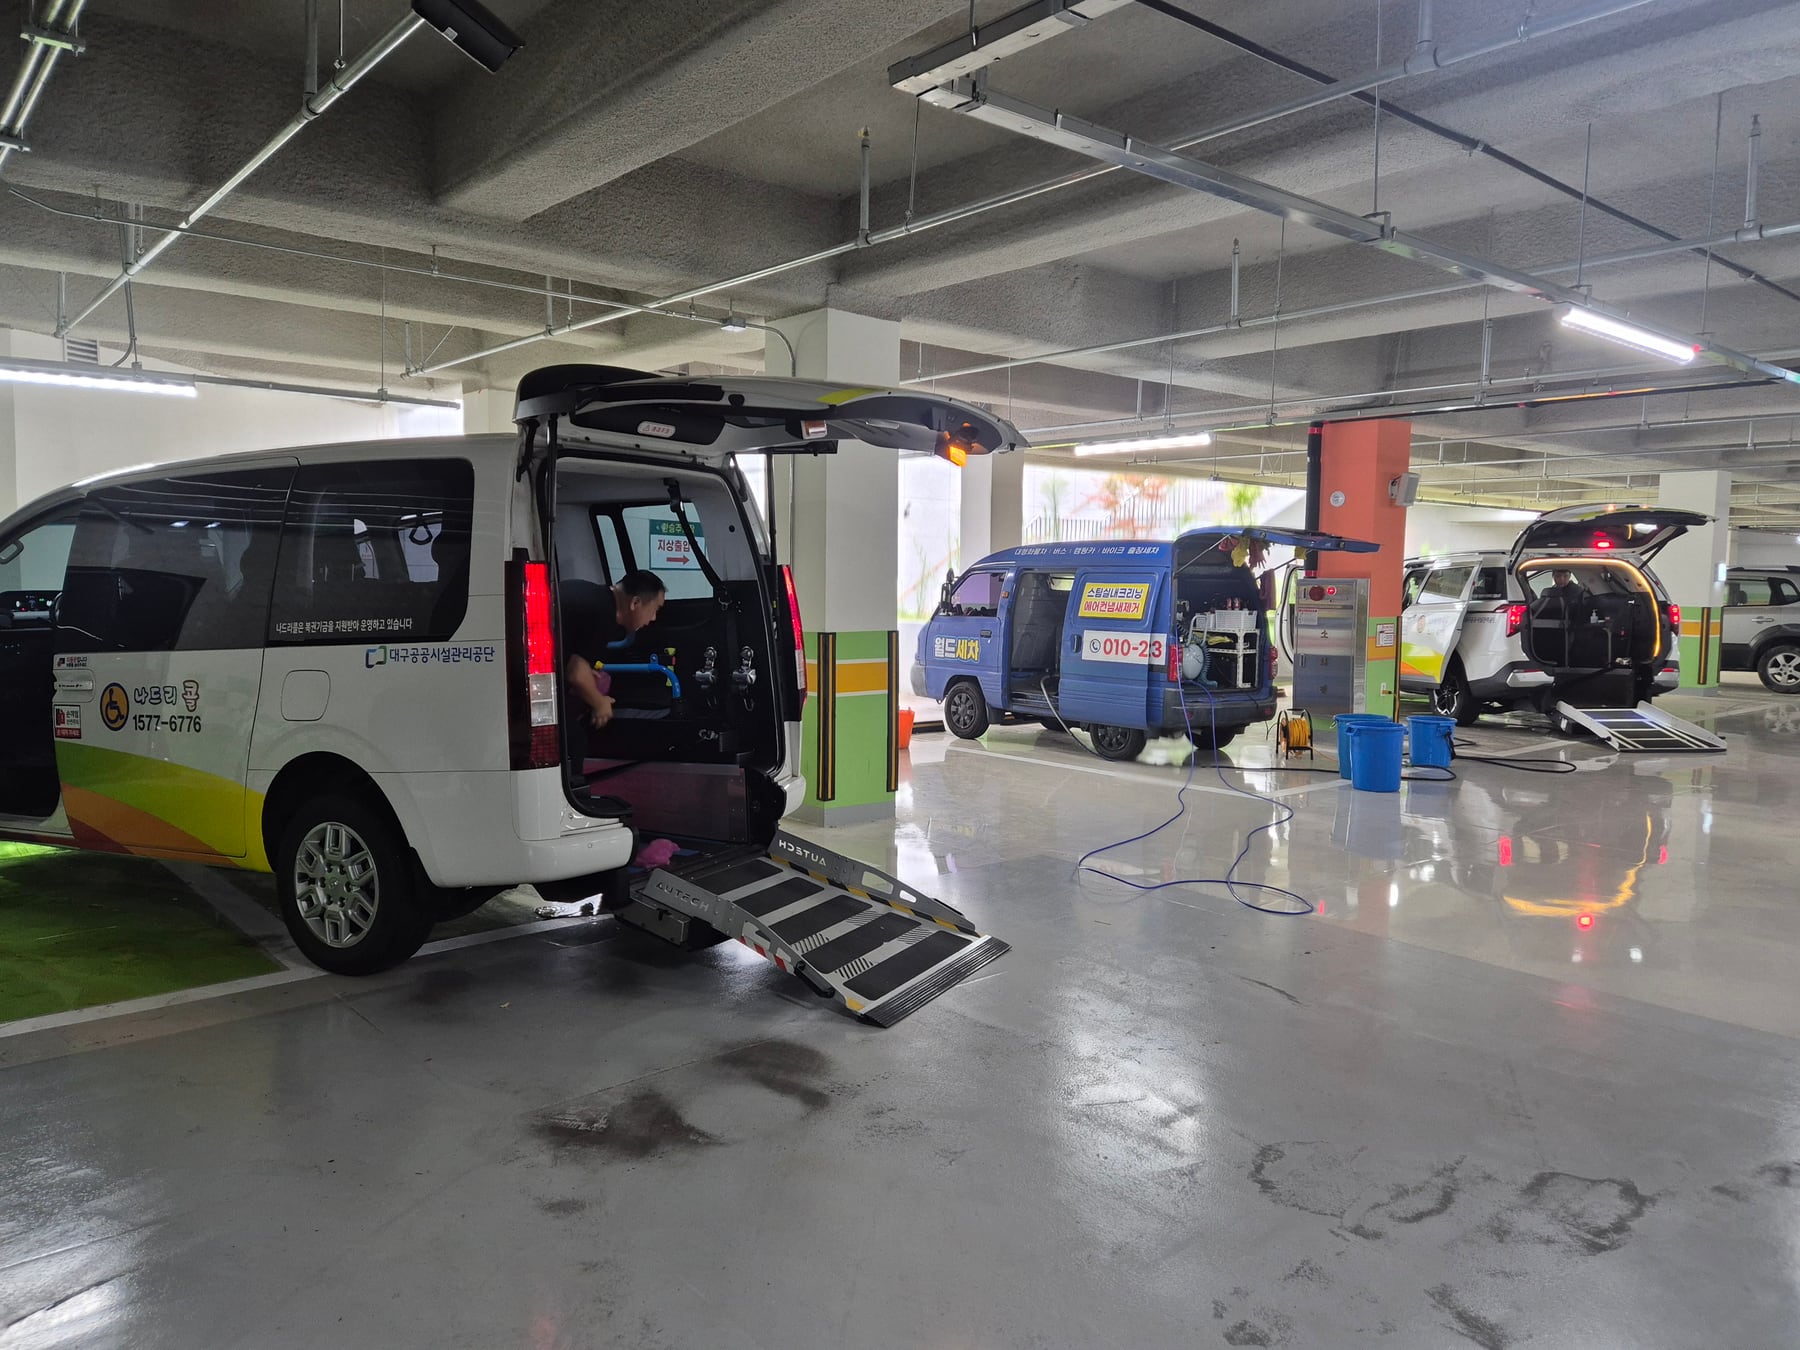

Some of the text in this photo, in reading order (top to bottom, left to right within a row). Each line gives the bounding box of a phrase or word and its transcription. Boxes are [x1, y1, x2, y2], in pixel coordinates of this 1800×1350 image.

[1052, 547, 1066, 555] 버스
[1101, 547, 1124, 555] 바이크
[1127, 546, 1160, 555] 출장세차
[1087, 587, 1144, 599] 스팀실내크리닝
[1084, 600, 1140, 613] 에어컨냄새제거
[305, 620, 335, 633] 복권기금을
[335, 619, 359, 633] 지원받아
[360, 618, 385, 632] 운영하고
[386, 617, 413, 631] 있습니다
[389, 646, 496, 664] 대구공공시설관리공단
[1103, 637, 1162, 659] 010-23
[133, 679, 200, 712] 나드리 콜
[132, 714, 201, 732] 1577-6776
[655, 881, 710, 912] AUTECH
